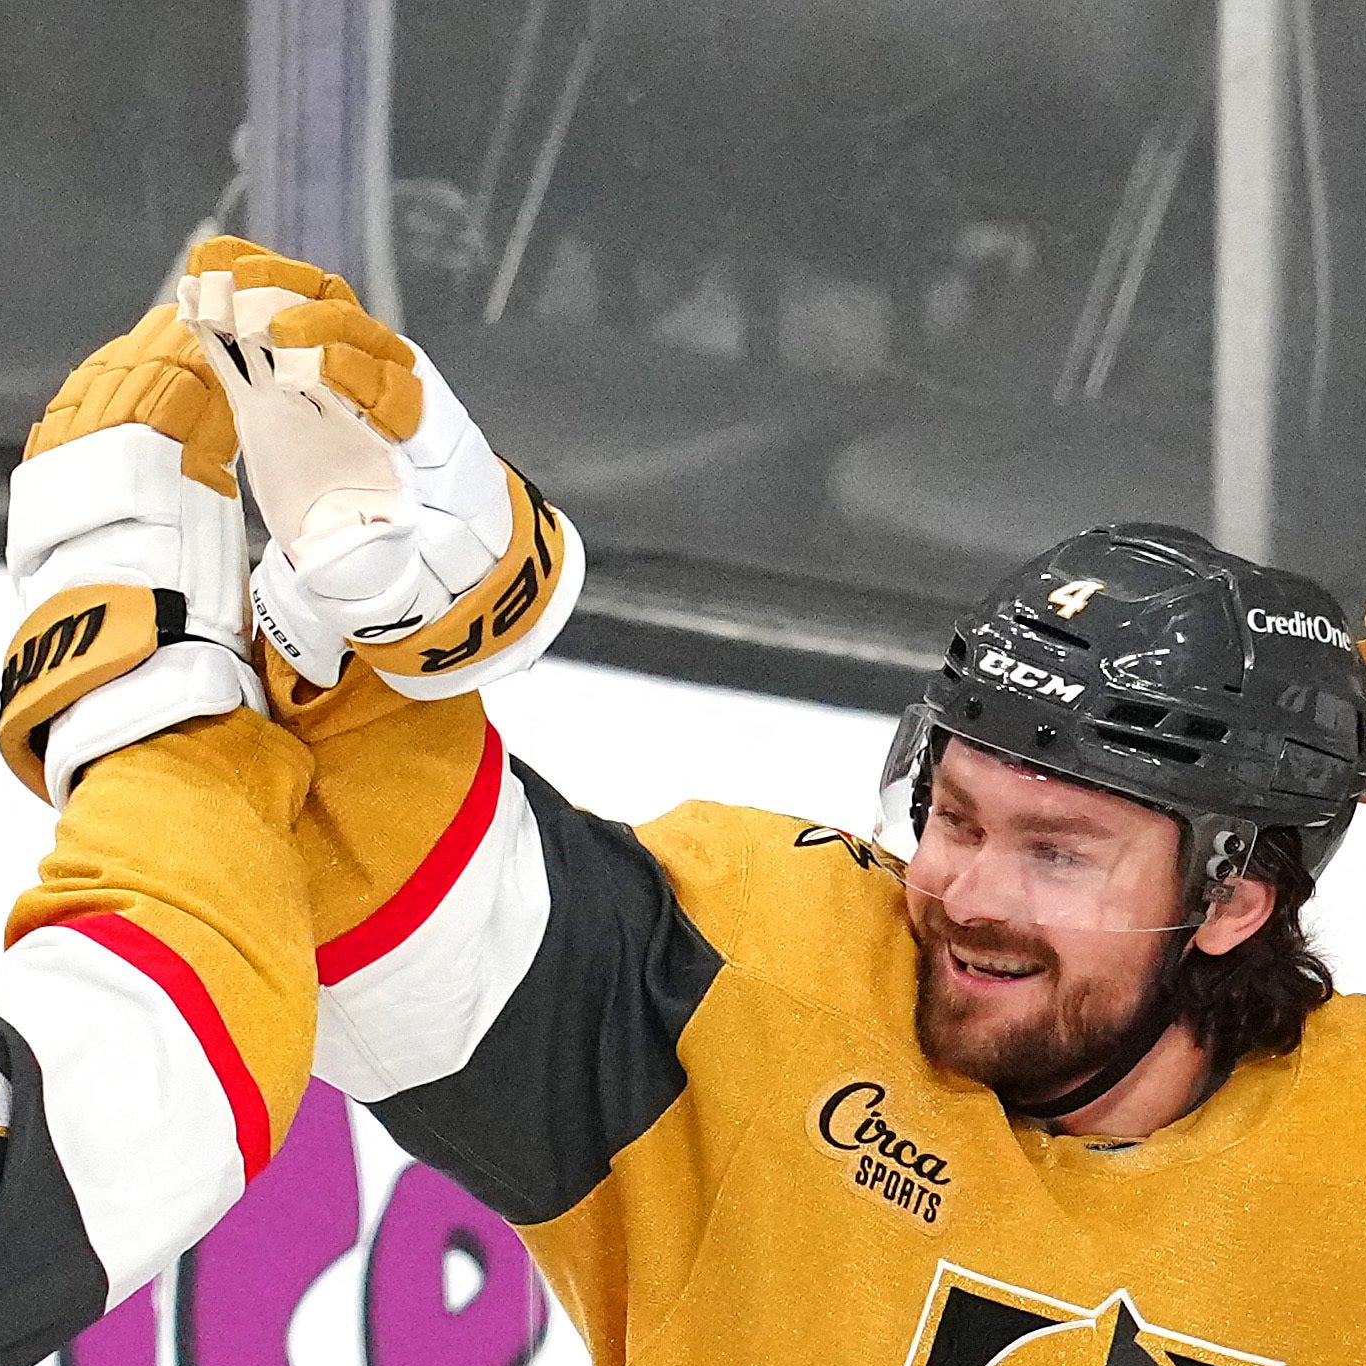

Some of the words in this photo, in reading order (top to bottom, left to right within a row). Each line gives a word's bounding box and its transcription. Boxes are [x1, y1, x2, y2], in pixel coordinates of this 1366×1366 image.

[1047, 578, 1104, 619] 4
[977, 649, 1086, 703] CCM
[818, 1081, 951, 1188] Circa
[854, 1154, 942, 1225] SPORTS
